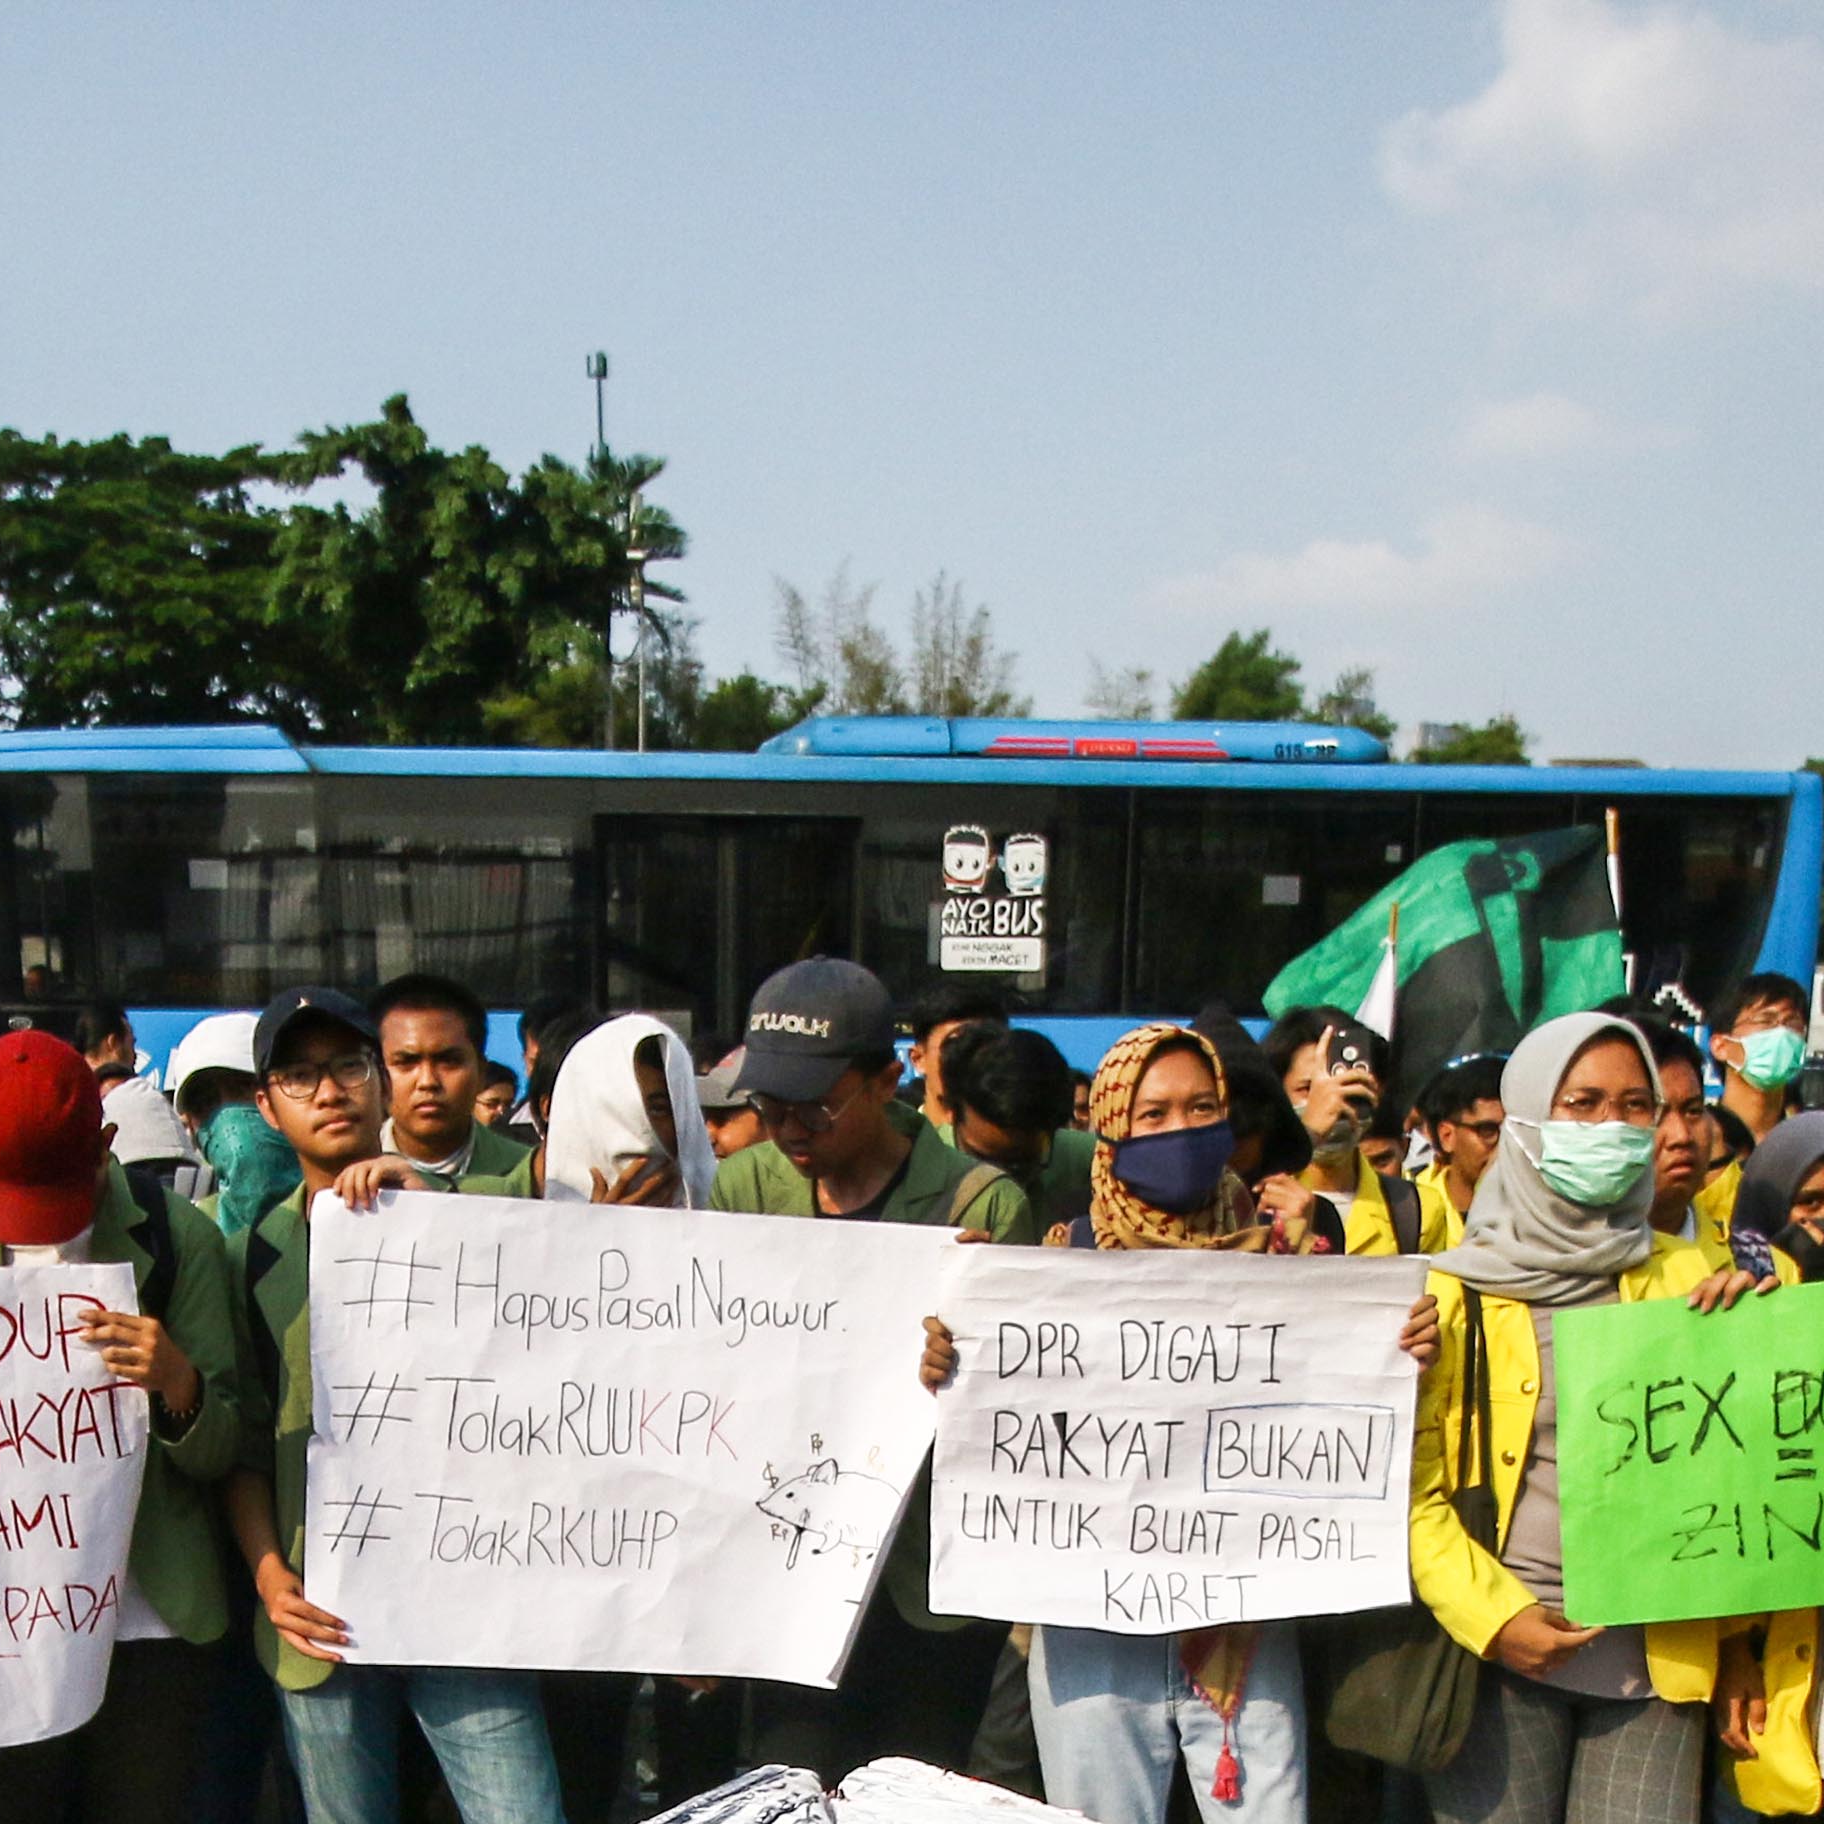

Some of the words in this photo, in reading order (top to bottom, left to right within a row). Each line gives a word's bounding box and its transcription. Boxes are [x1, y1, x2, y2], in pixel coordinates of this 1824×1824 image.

[942, 898, 990, 919] AYO
[993, 899, 1044, 936] BUS
[942, 919, 990, 936] NAIK
[997, 1321, 1085, 1380] DPR
[1119, 1319, 1286, 1384] DIGAJI
[990, 1408, 1186, 1480] RAKYAT
[1216, 1414, 1375, 1483] BUKAN
[1595, 1369, 1746, 1478] SEX
[960, 1492, 1103, 1550] UNTUK
[1128, 1503, 1240, 1557] BUAT
[1258, 1511, 1378, 1562] PASAL
[1103, 1568, 1259, 1624] KARET
